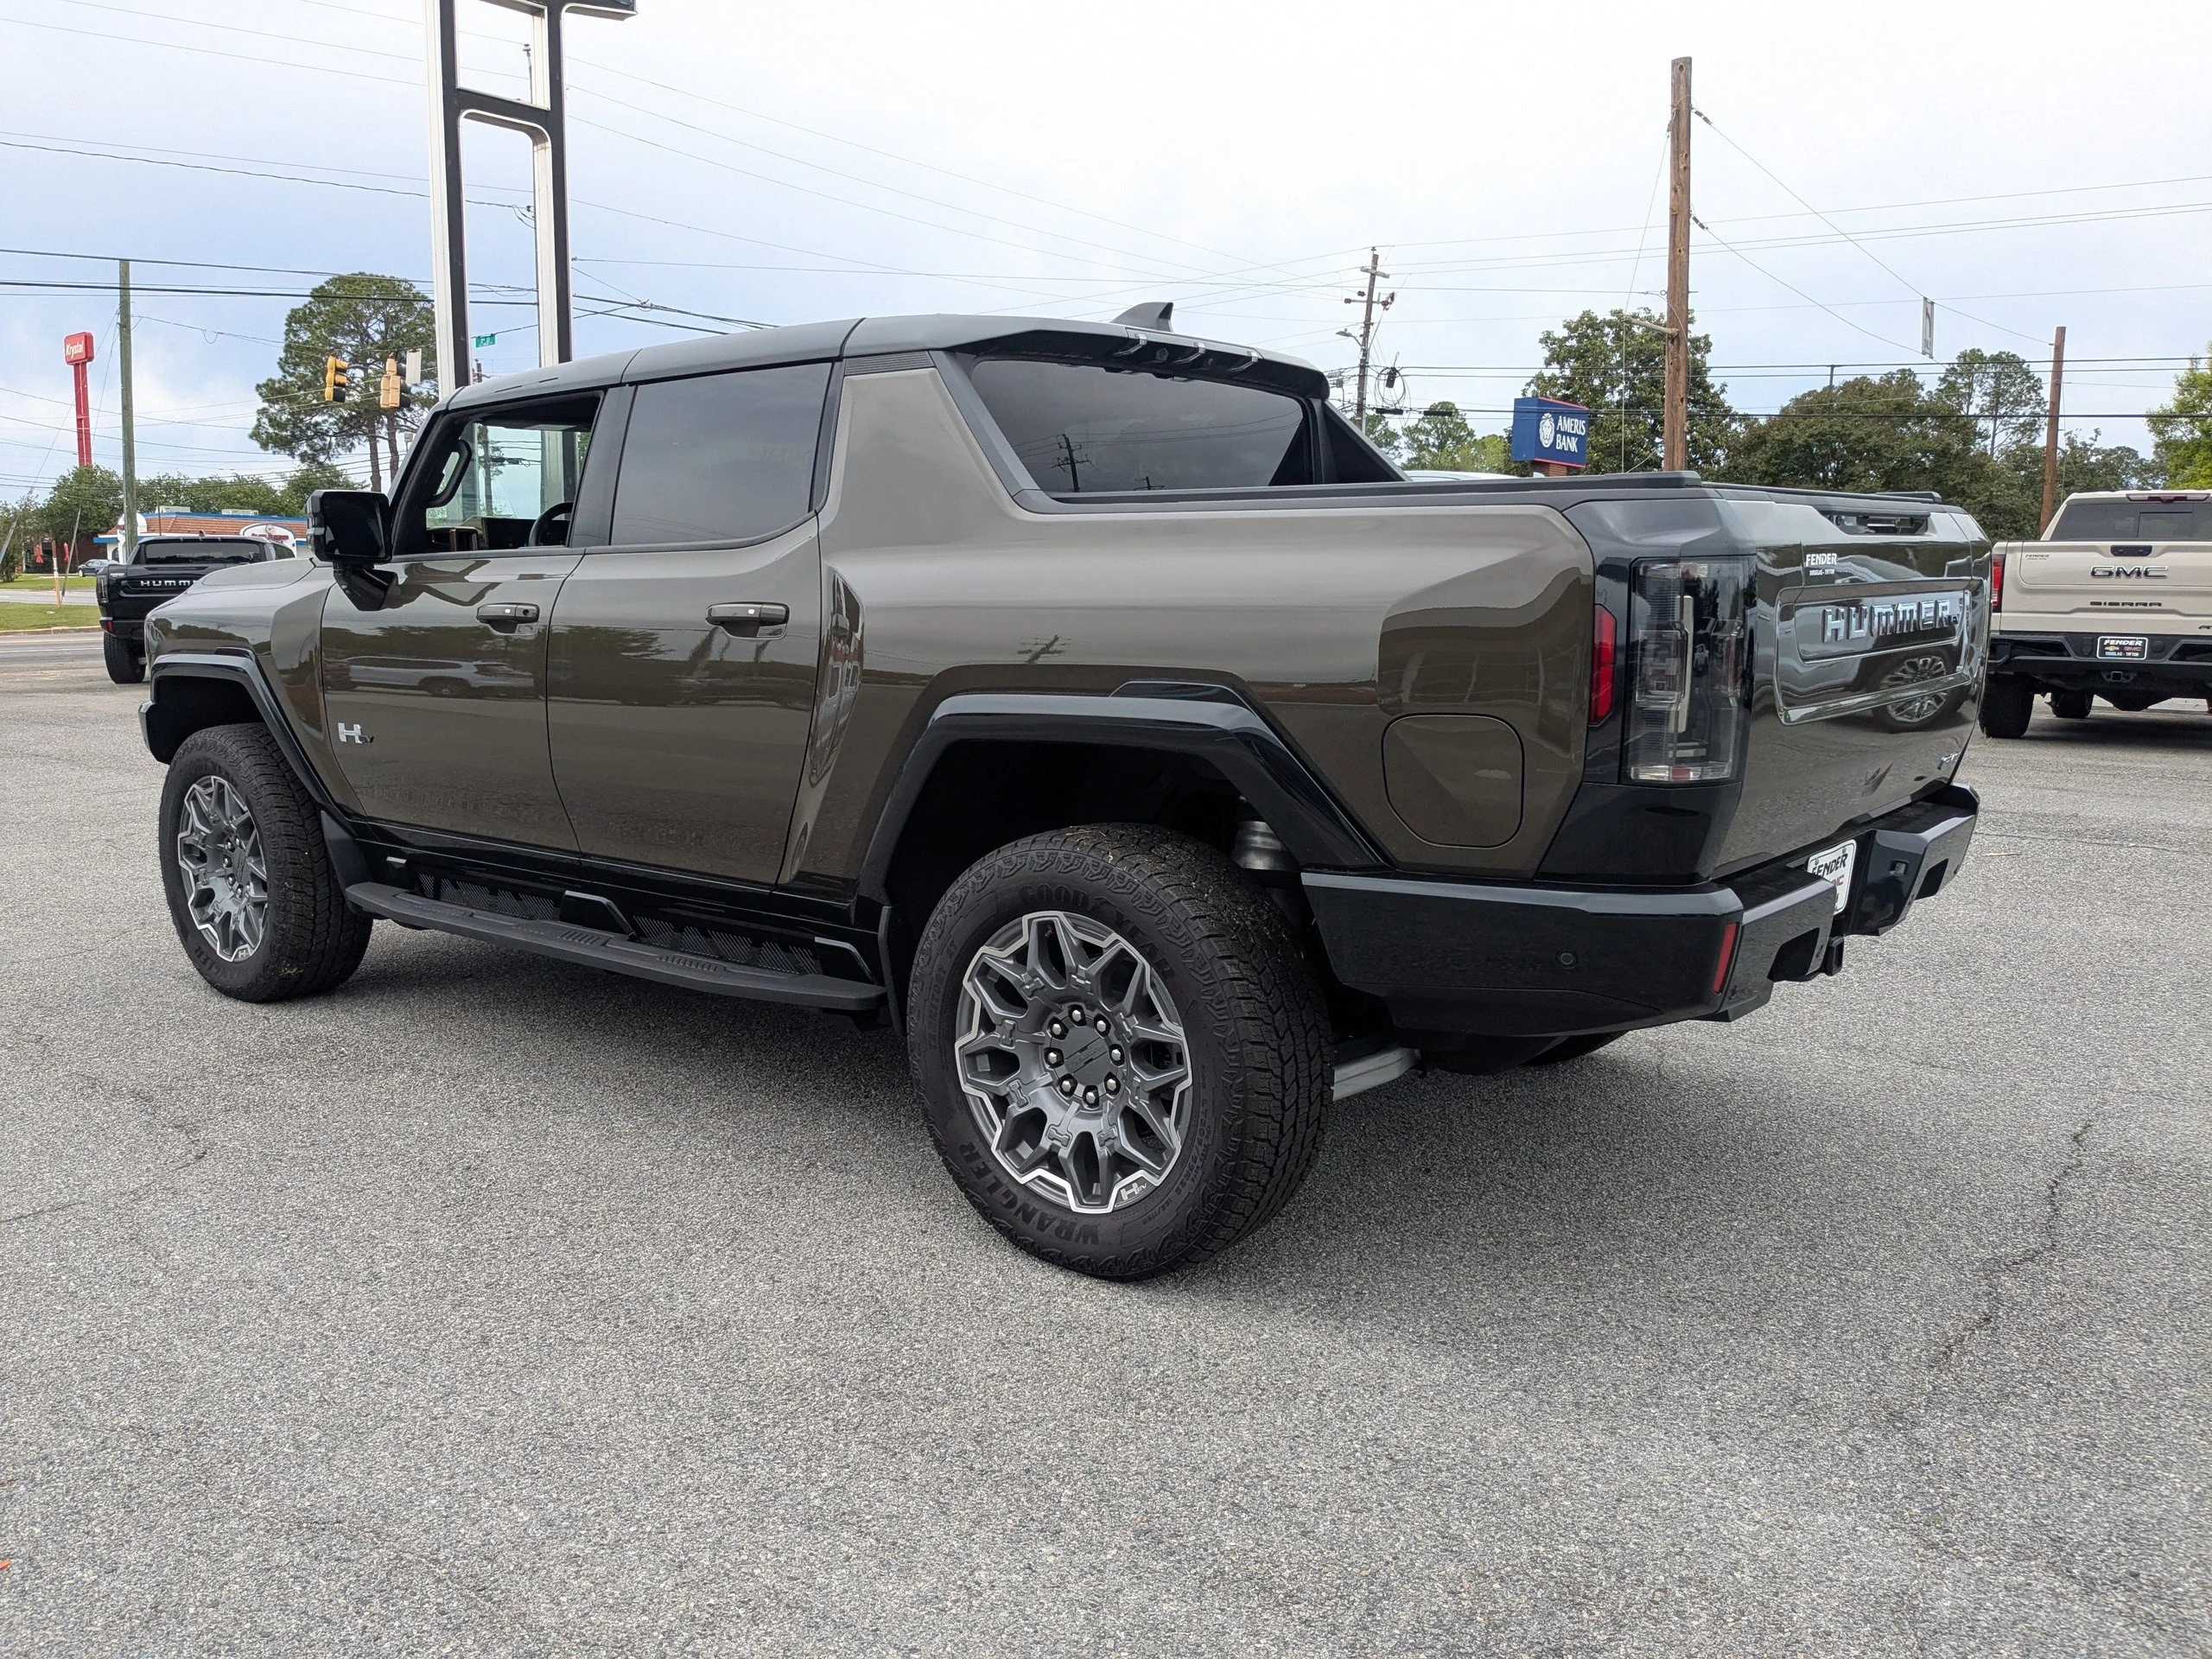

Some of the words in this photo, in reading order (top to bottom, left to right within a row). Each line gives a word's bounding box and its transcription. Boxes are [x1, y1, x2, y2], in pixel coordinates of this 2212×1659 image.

[1556, 416, 1586, 435] AMERIS
[1556, 434, 1578, 453] BANK
[1806, 553, 1838, 567] FENDER
[2090, 566, 2169, 579] GMC
[1821, 599, 1951, 643] HUMMER
[1812, 853, 1848, 876] FENDER
[957, 1140, 1101, 1245] WRANGLER
